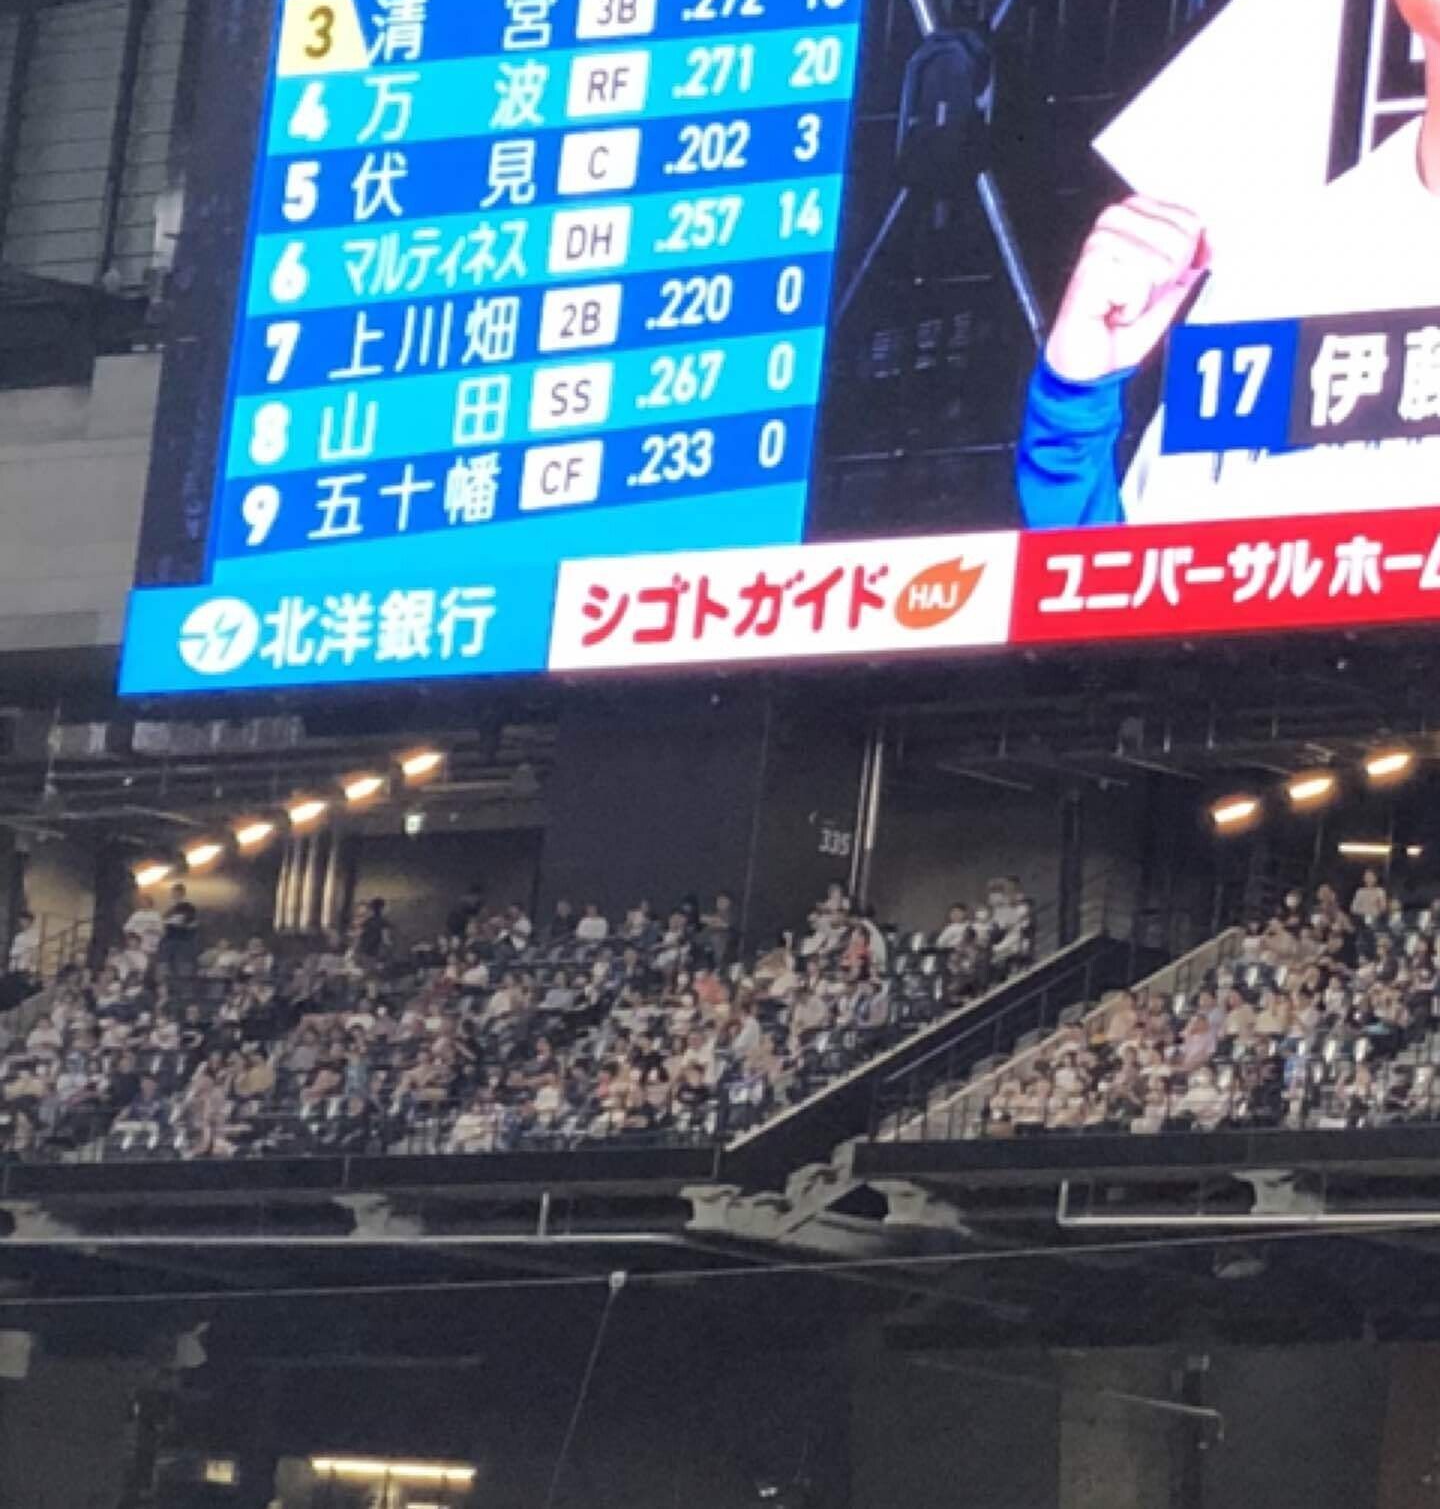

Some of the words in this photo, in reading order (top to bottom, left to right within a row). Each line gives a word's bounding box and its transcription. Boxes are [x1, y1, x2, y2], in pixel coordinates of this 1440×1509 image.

[305, 6, 334, 58] 3
[290, 81, 328, 140] 4
[588, 68, 629, 101] RF
[674, 45, 753, 97] .271
[790, 37, 840, 86] 20
[283, 162, 318, 221] 5
[588, 146, 608, 179] C
[665, 121, 750, 173] .202
[795, 114, 820, 160] 3
[271, 242, 307, 302] 6
[343, 221, 527, 294] マルティネス
[567, 223, 612, 259] DH
[656, 196, 742, 251] .257
[781, 191, 821, 236] 14
[267, 322, 300, 382] 7
[560, 301, 600, 338] 2B
[647, 275, 732, 329] .220
[777, 266, 802, 312] 0
[250, 403, 289, 464] 8
[552, 380, 590, 416] SS
[637, 351, 724, 407] .267
[768, 342, 794, 390] 0
[1198, 345, 1271, 417] 17
[243, 485, 279, 545] 9
[541, 458, 582, 494] CF
[628, 430, 713, 485] .233
[759, 420, 784, 467] 0
[260, 587, 496, 667] 北洋銀行
[583, 566, 888, 645] シゴトガイド
[906, 583, 960, 612] HAJ
